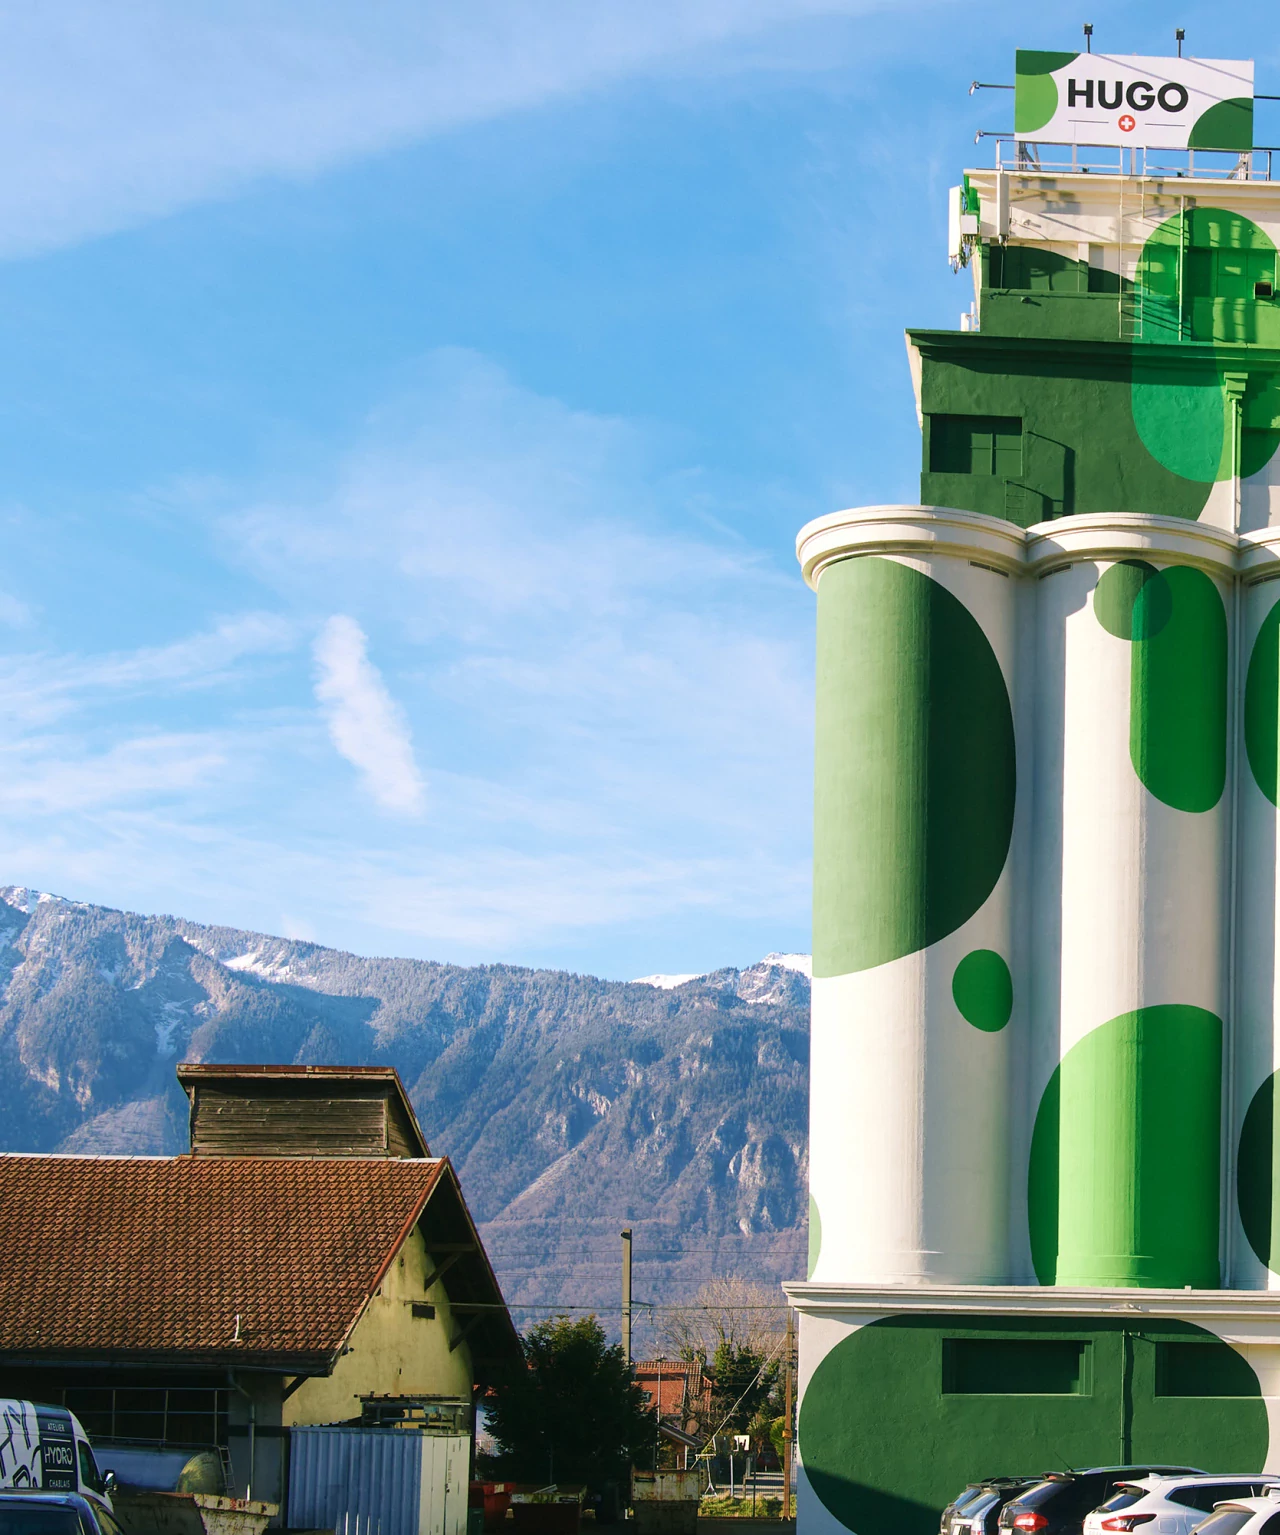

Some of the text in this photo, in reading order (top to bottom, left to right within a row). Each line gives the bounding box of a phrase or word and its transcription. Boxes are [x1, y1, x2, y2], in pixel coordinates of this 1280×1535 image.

[1068, 78, 1189, 112] HUGO
[47, 1422, 65, 1432] ATELIER
[43, 1446, 73, 1466] HYDRO
[48, 1479, 71, 1489] CHABLAIS
